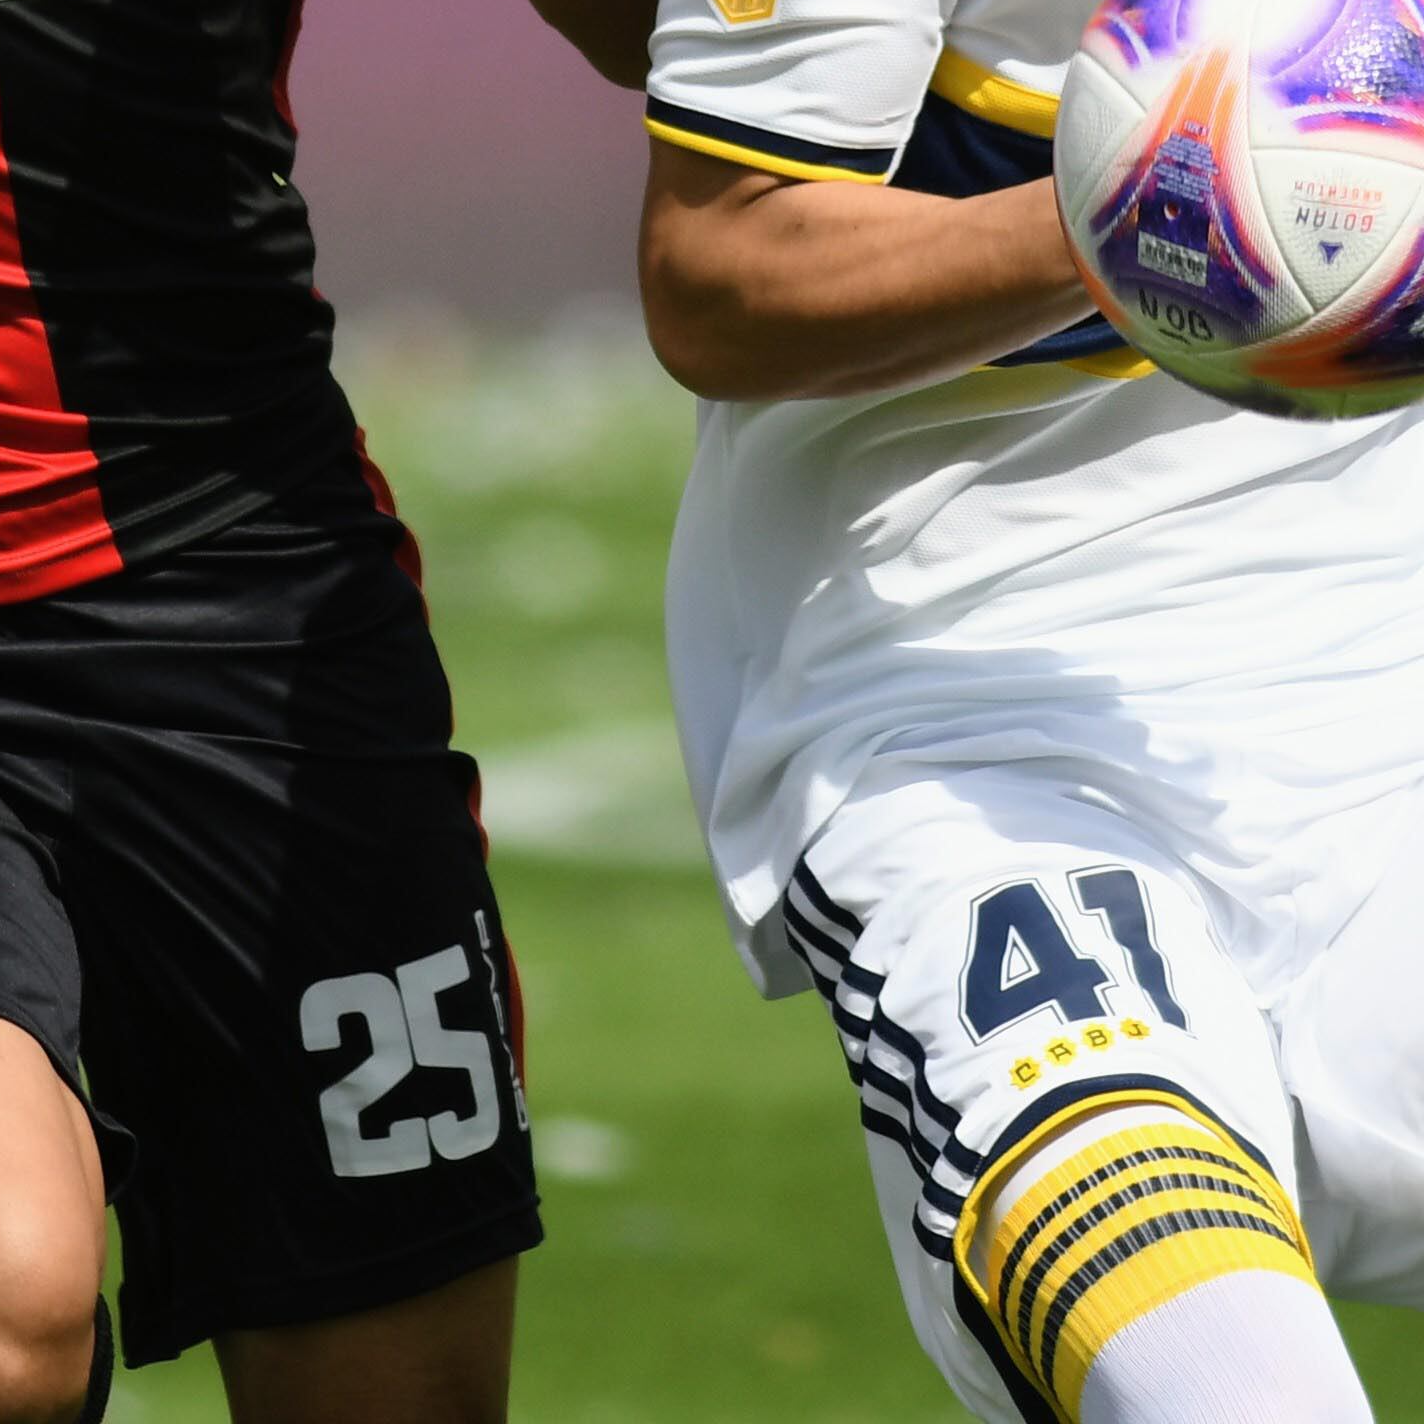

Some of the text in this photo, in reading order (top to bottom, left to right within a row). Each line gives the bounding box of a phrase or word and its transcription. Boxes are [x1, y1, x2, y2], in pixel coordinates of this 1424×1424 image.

[958, 864, 1198, 1046] 41
[298, 944, 502, 1178] 25
[1011, 1021, 1148, 1087] CABJ
